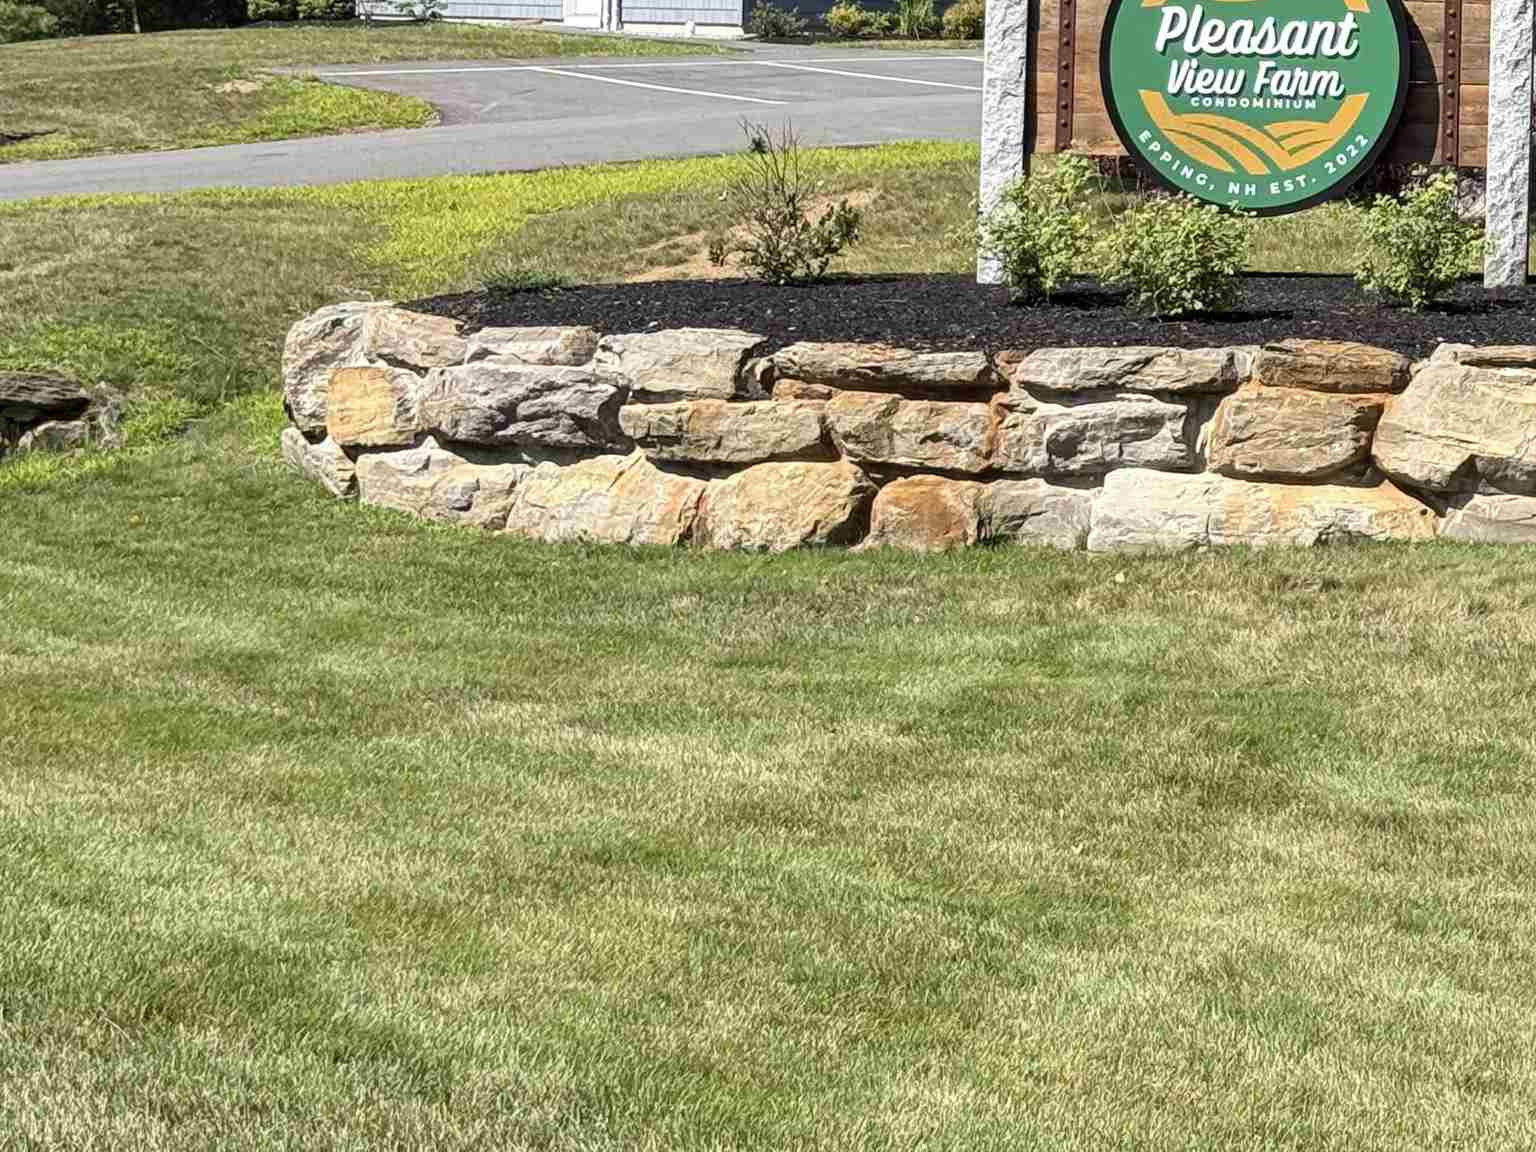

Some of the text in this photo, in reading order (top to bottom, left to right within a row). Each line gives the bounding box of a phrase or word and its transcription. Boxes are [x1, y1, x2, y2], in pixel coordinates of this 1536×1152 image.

[1154, 4, 1360, 56] Pleasant
[1167, 58, 1345, 97] View Farm
[1190, 97, 1317, 109] CONDOMINIUM
[1138, 129, 1369, 196] EPPING, NH EST. 2022
